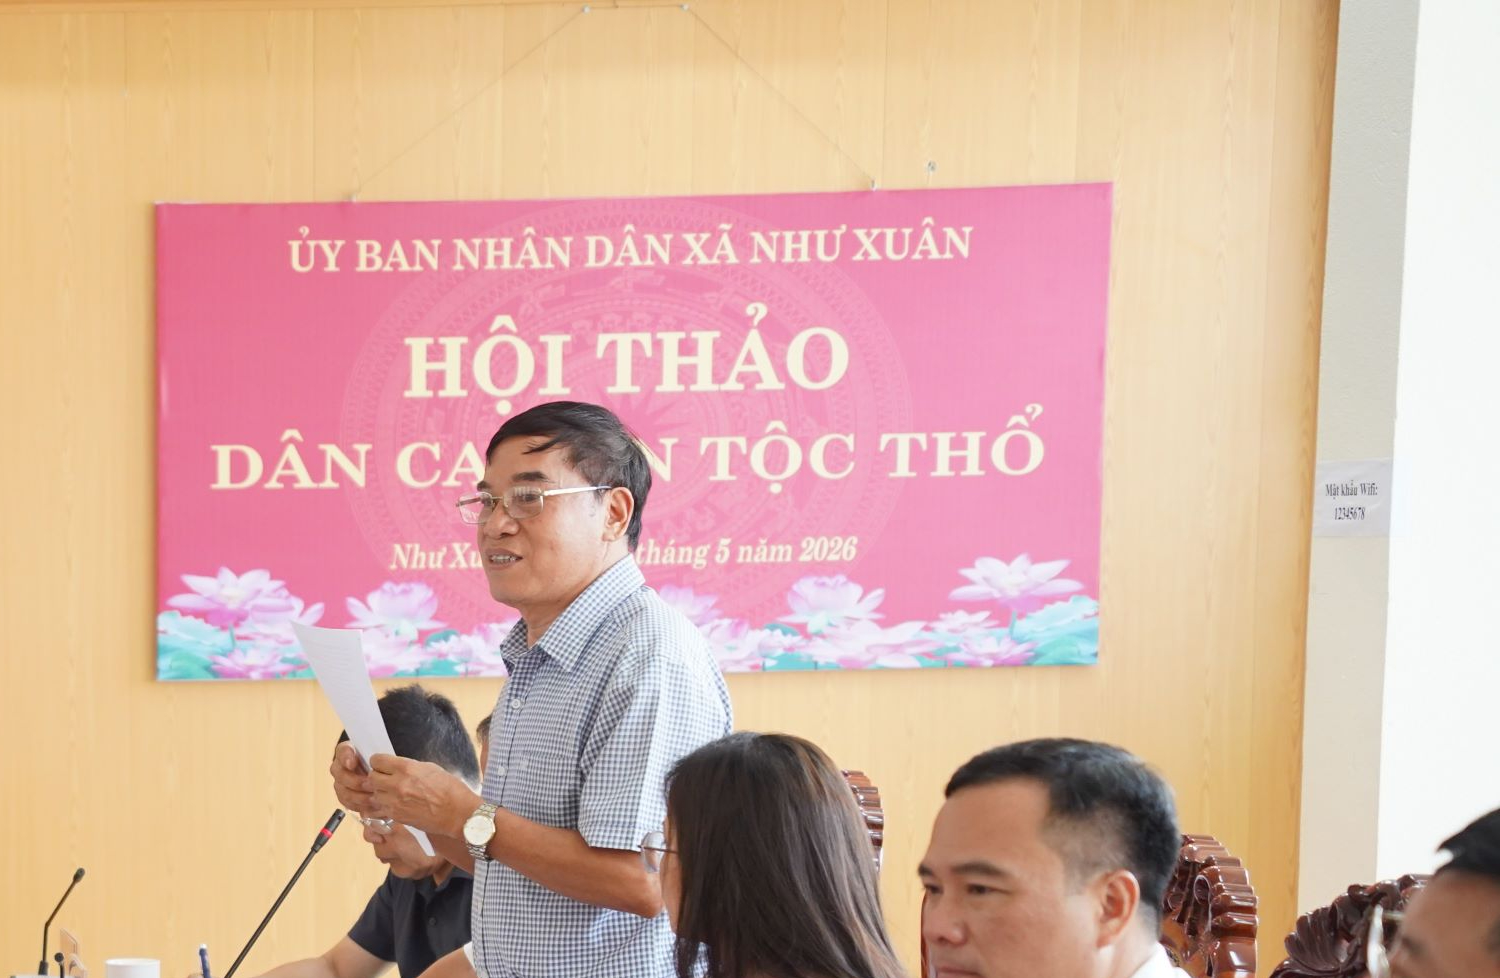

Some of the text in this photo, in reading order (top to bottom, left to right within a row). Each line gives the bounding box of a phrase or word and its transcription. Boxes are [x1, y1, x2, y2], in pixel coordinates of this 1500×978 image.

[288, 216, 973, 273] ỦY BAN NHÂN DÂN XÃ NHƯ XUÂN
[403, 302, 849, 415] HỘI THẢO
[210, 429, 372, 490] DÂN
[396, 440, 485, 489] CA
[700, 420, 856, 494] TỘC
[879, 403, 1046, 478] THỔ
[1334, 507, 1366, 520] 12345678
[389, 543, 447, 571] Như
[635, 536, 709, 569] tháng
[715, 536, 731, 564] 5
[737, 541, 793, 564] năm
[799, 535, 859, 563] 2026
